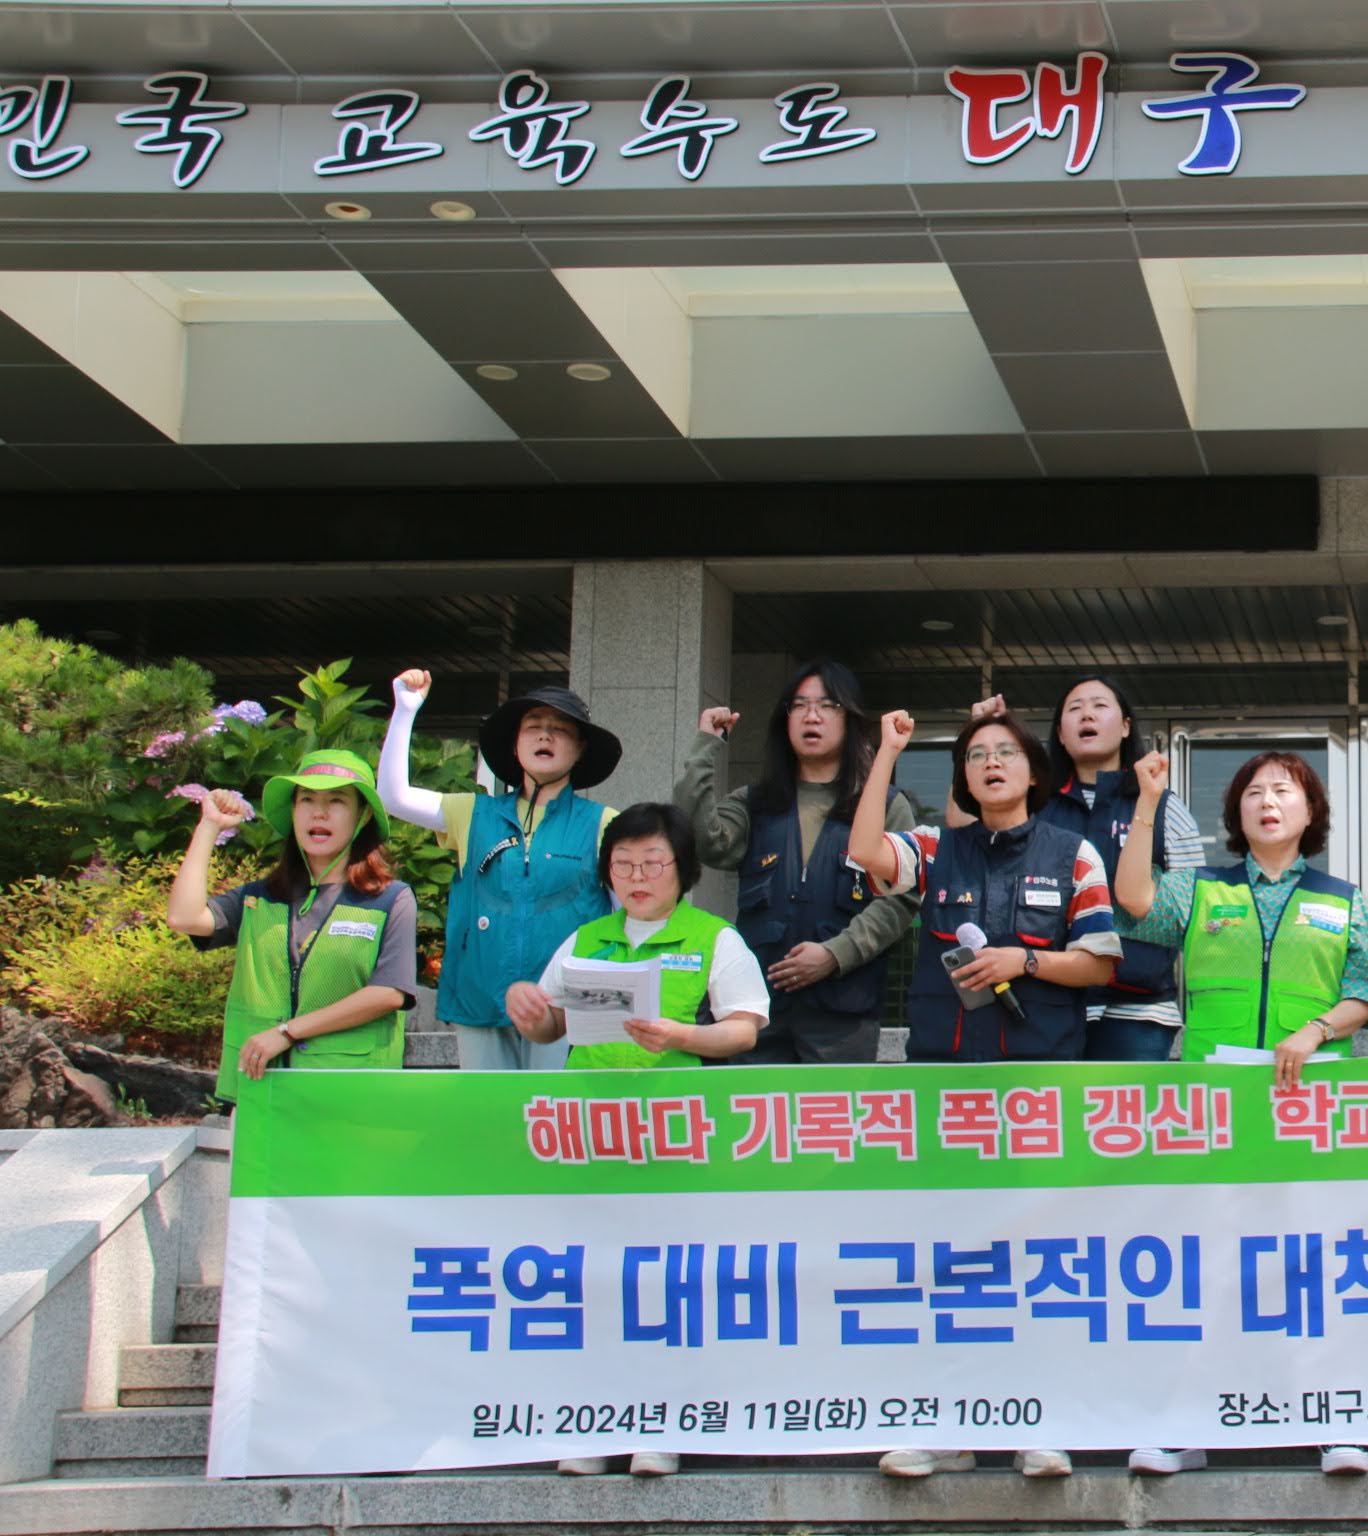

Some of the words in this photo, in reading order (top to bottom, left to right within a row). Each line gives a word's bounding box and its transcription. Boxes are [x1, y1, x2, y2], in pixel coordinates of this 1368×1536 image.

[944, 51, 1307, 176] 대구
[524, 1095, 714, 1165] 해마다
[731, 1089, 917, 1163] 기록적
[938, 1087, 1063, 1160] 폭염
[1084, 1083, 1233, 1158] 갱신!
[406, 1244, 586, 1352] 폭염
[622, 1241, 799, 1348] 대비
[833, 1234, 1203, 1345] 근본적인
[473, 1403, 544, 1438] 일시:
[555, 1401, 667, 1435] 2024년
[679, 1400, 729, 1434] 6월
[745, 1396, 867, 1432] 11일(화)
[878, 1397, 939, 1428] 오전
[954, 1397, 1043, 1427] 10:00
[1218, 1392, 1290, 1427] 장소:
